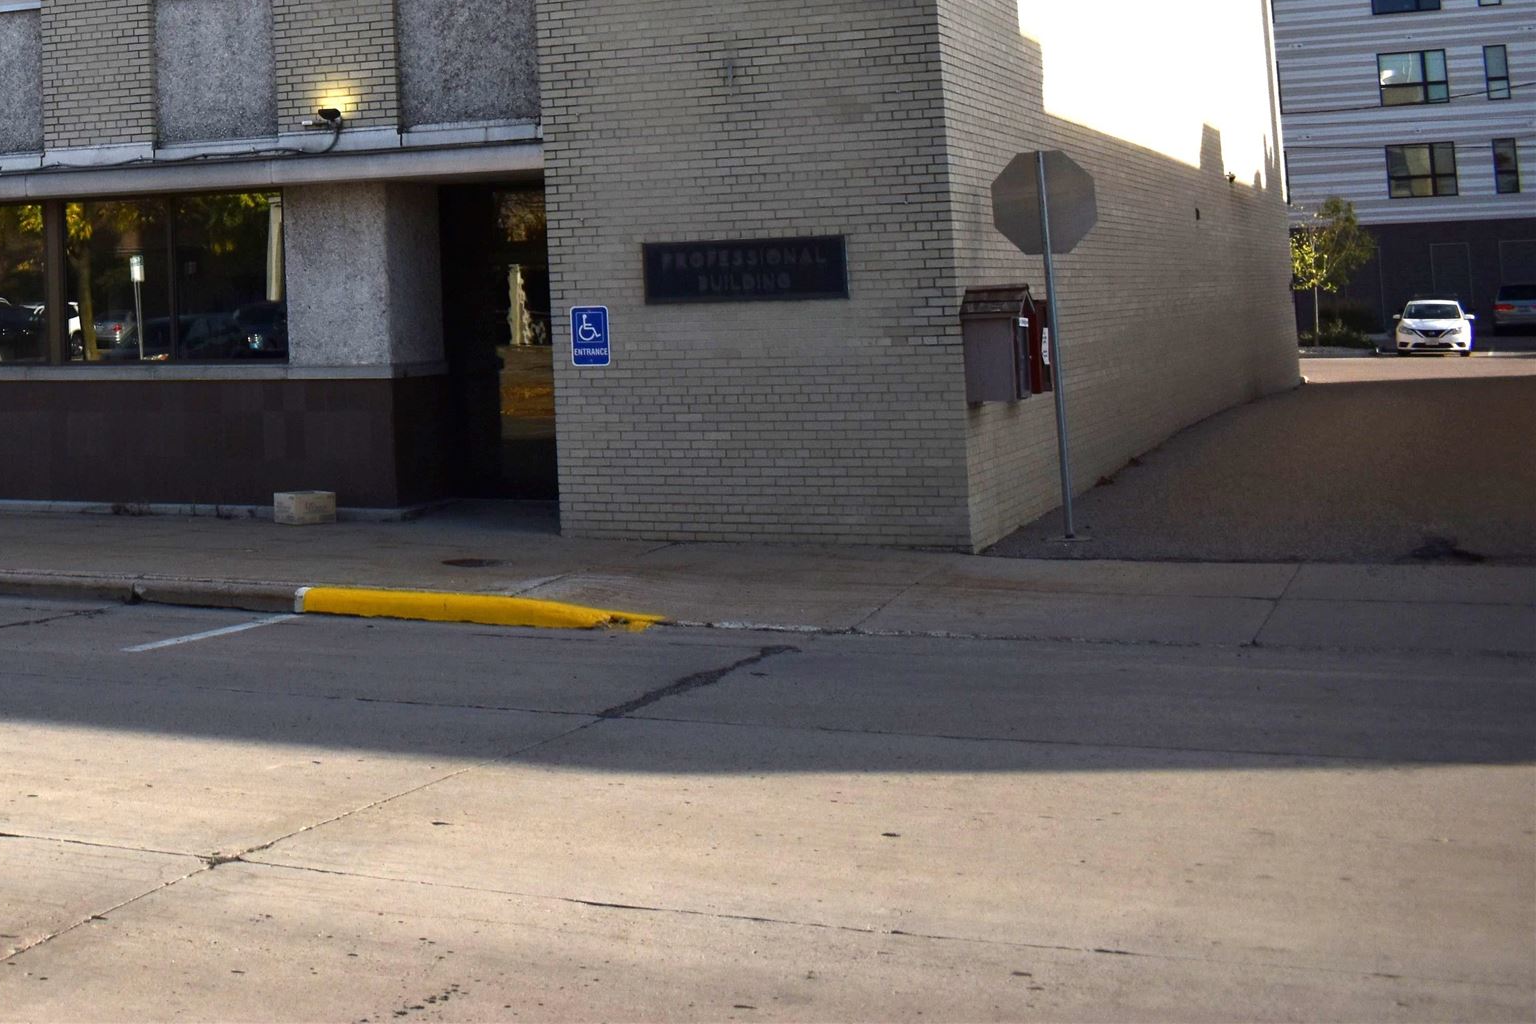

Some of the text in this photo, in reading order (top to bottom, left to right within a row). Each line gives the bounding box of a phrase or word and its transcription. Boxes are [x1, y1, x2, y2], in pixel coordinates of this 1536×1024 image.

[662, 247, 827, 270] PROFESSIONAL
[698, 272, 792, 291] BUILDING
[574, 347, 608, 356] ENTRANCE
